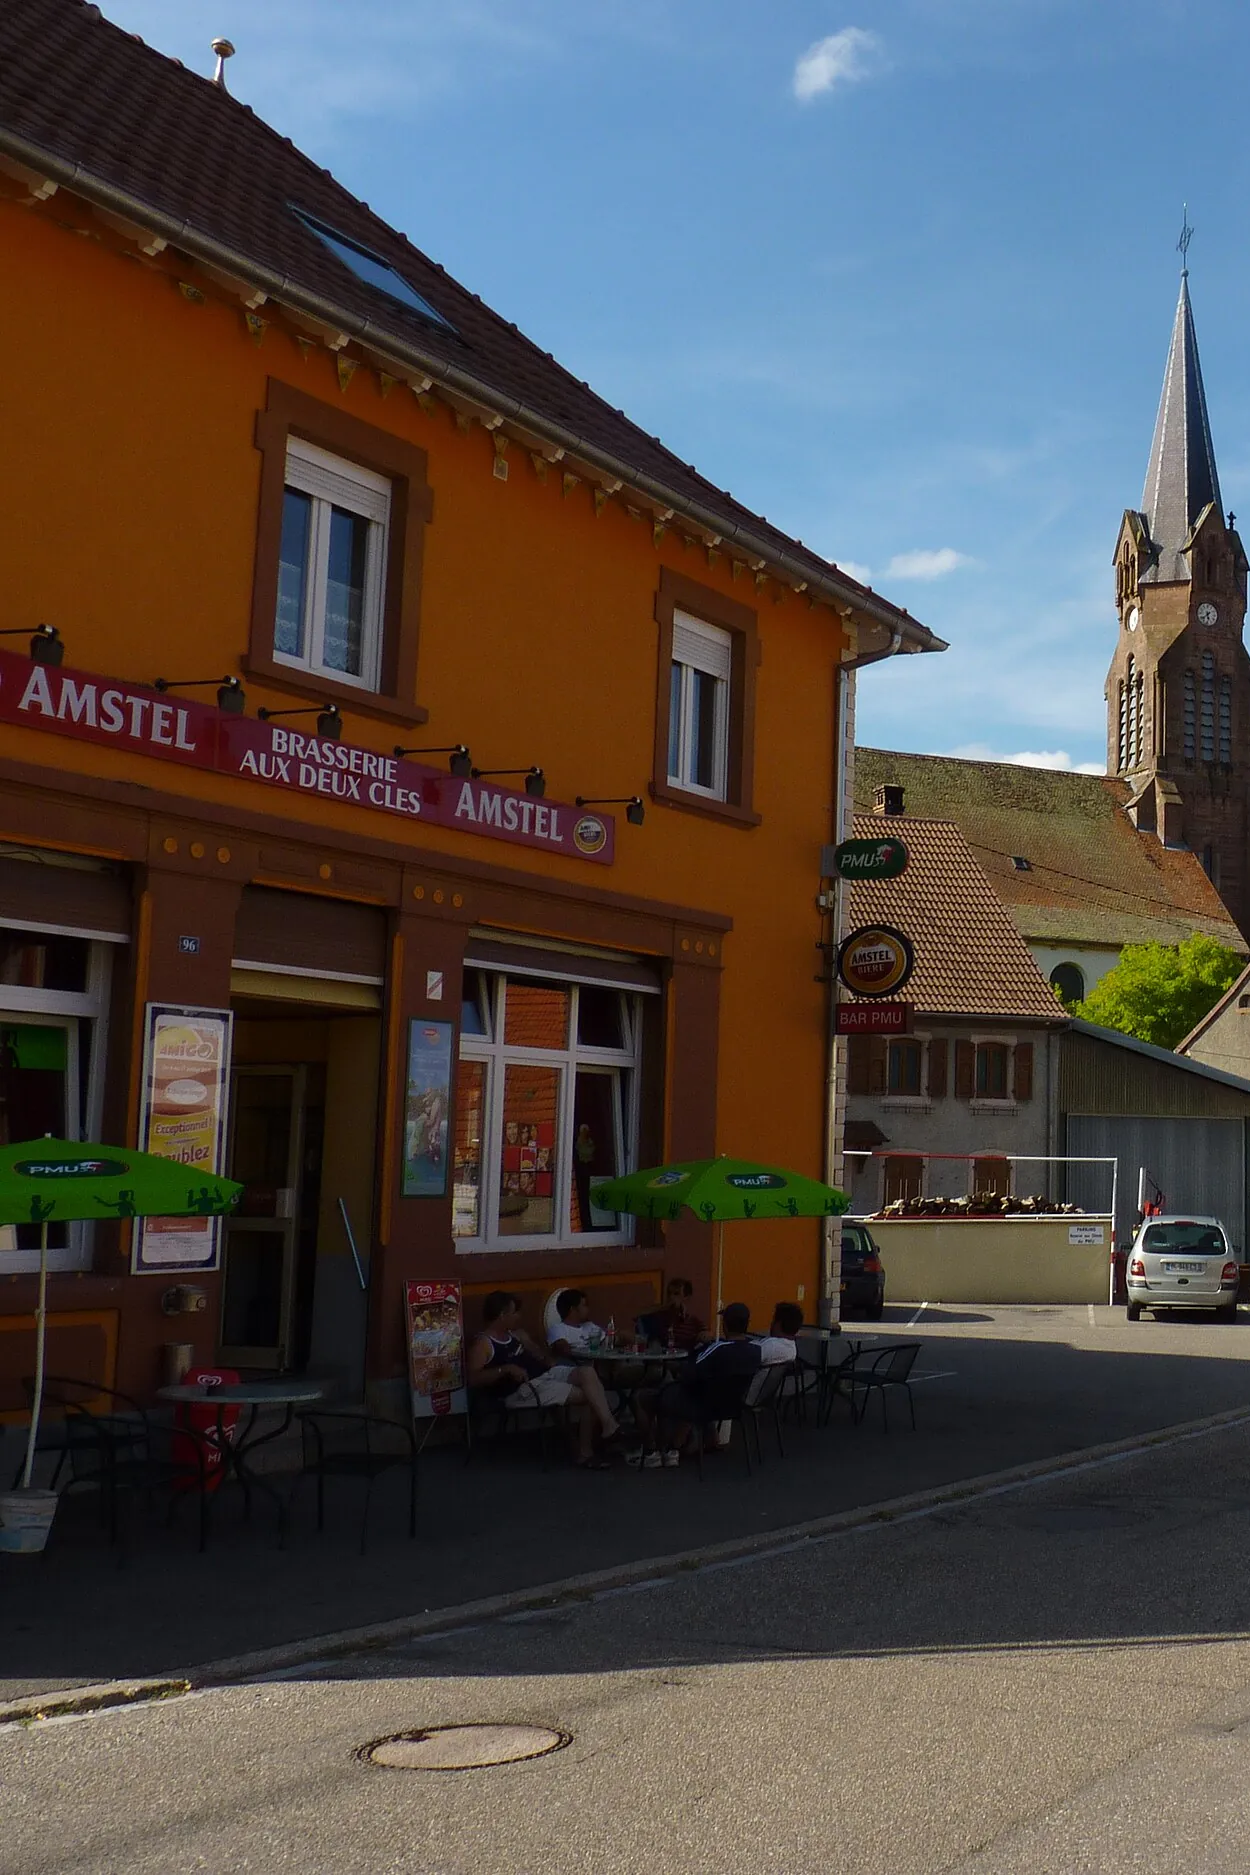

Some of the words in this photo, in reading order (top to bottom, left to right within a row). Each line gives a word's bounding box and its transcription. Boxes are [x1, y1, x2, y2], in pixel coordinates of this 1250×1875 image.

[17, 665, 196, 751] AMSTEL
[271, 727, 398, 783] BRASSERIE
[239, 749, 291, 783] AUX
[299, 763, 361, 800] DEUX
[368, 782, 421, 814] CLES
[455, 782, 563, 841] AMSTEL
[840, 852, 875, 868] PMU
[183, 938, 196, 951] 96
[851, 950, 891, 965] AMSTEL
[840, 1012, 867, 1025] BAR
[871, 1011, 902, 1025] PMU
[27, 1164, 79, 1174] PMU
